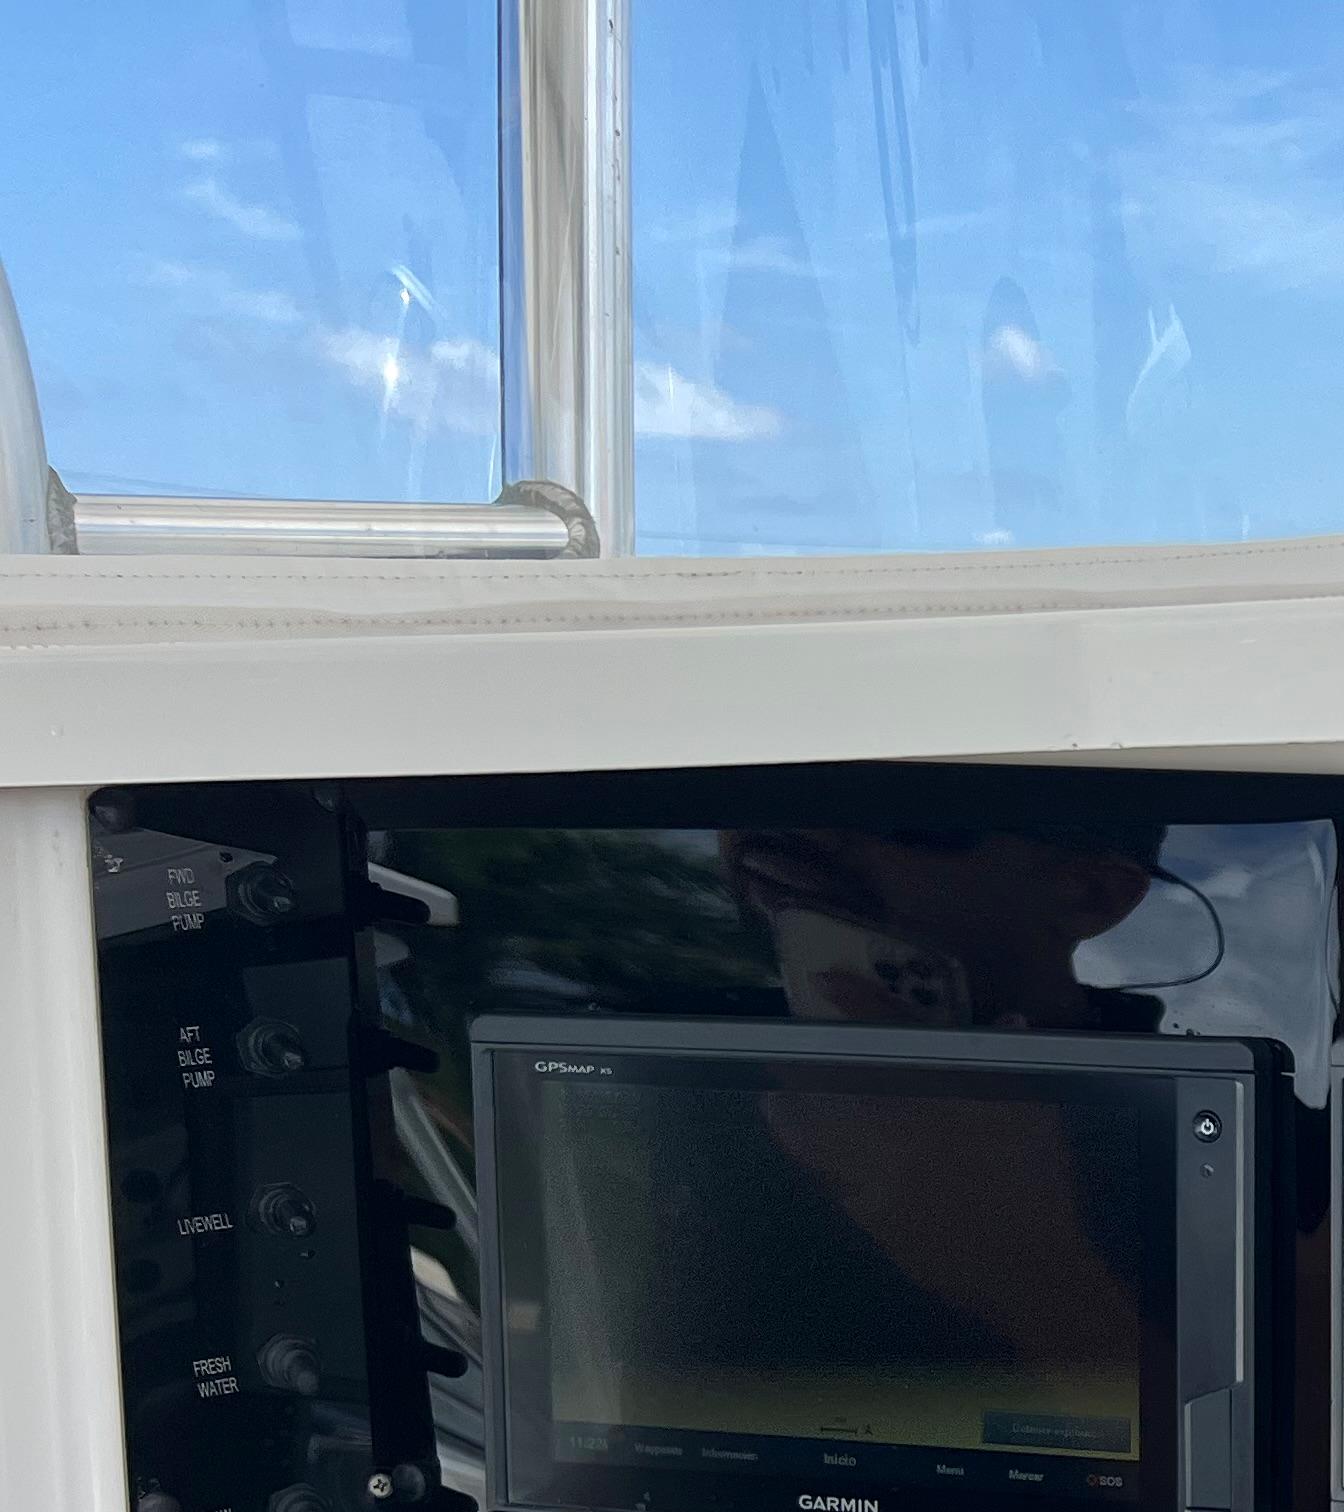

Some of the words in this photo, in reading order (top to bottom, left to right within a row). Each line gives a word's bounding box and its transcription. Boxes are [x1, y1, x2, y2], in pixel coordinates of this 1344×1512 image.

[168, 868, 195, 885] FWD
[166, 890, 202, 909] BILGE
[171, 913, 205, 931] PUMP
[180, 1026, 200, 1043] AFT
[177, 1048, 213, 1067] BILGE
[182, 1070, 215, 1088] PUMP
[177, 1213, 234, 1235] LIVEWELL
[193, 1355, 232, 1377] FRESH
[197, 1377, 240, 1398] WATER
